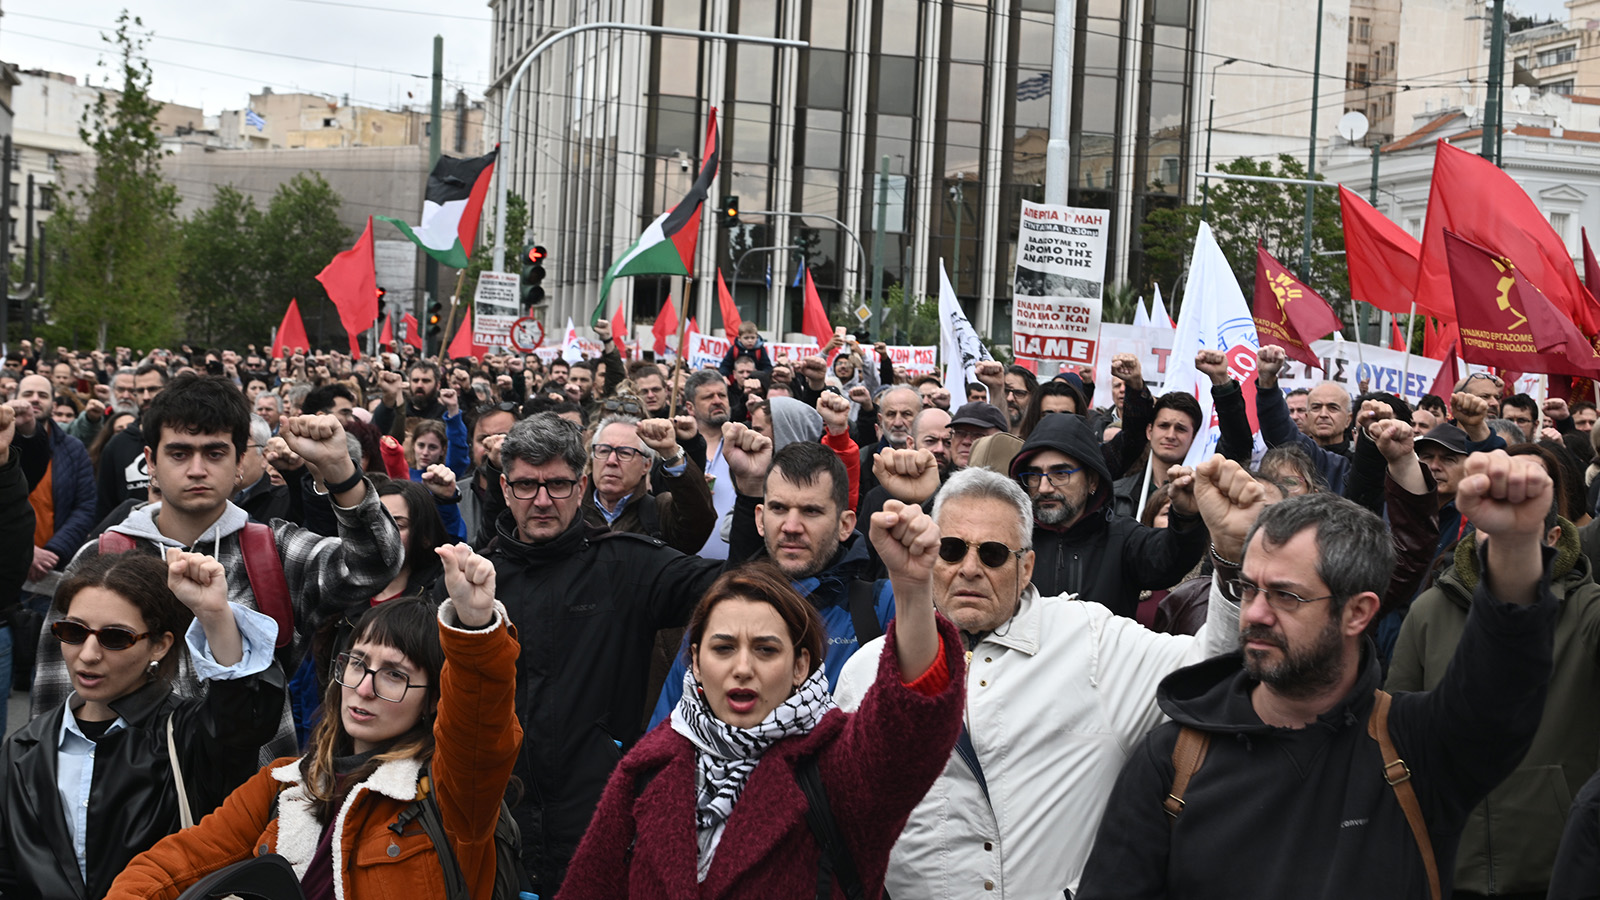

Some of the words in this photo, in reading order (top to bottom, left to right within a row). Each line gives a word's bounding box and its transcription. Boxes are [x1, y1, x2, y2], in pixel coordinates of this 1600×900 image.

[1024, 207, 1058, 220] ΑΠΕΡΓΙΑ
[1074, 214, 1102, 225] ΜΑΗ
[1024, 244, 1062, 255] ΔΡΟΜΟ
[1068, 249, 1093, 258] ΤΗΣ
[1023, 253, 1092, 268] ΑΝΑΤΡΟΠΗΣ
[1017, 300, 1053, 312] ΕΝΑΝΤΙΑ
[1058, 305, 1090, 316] ΣΤΟΝ
[1017, 309, 1060, 320] ΠΟΛΕΜΟ
[1066, 315, 1090, 324] ΚΑΙ
[1015, 334, 1088, 359] ΠΑΜΕ
[1356, 362, 1428, 398] ΟΥΣΙΕΣ
